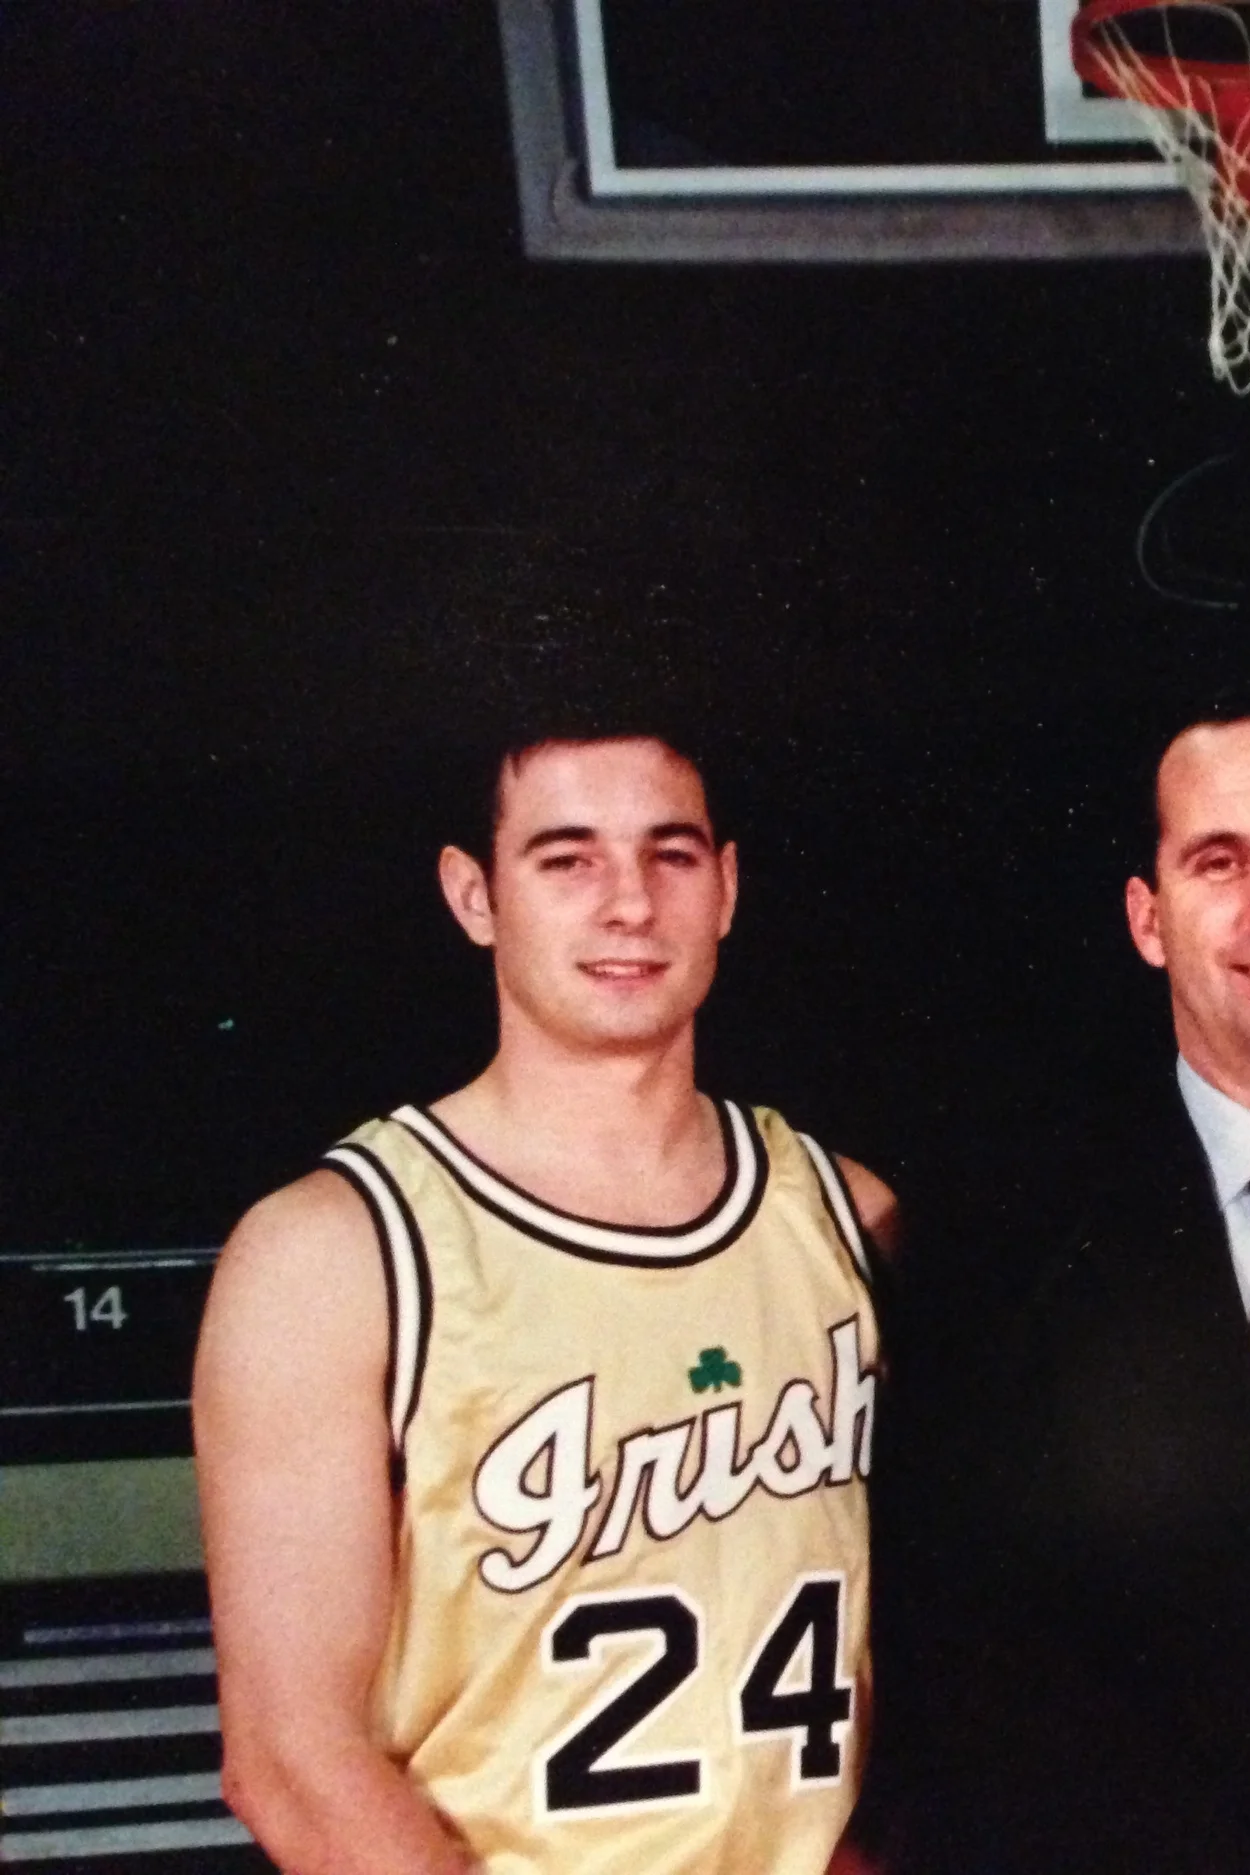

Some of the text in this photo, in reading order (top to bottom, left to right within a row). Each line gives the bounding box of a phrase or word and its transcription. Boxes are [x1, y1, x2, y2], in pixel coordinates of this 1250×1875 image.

[64, 1285, 128, 1330] 14
[472, 1313, 876, 1594] Irish
[537, 1574, 854, 1820] 24
